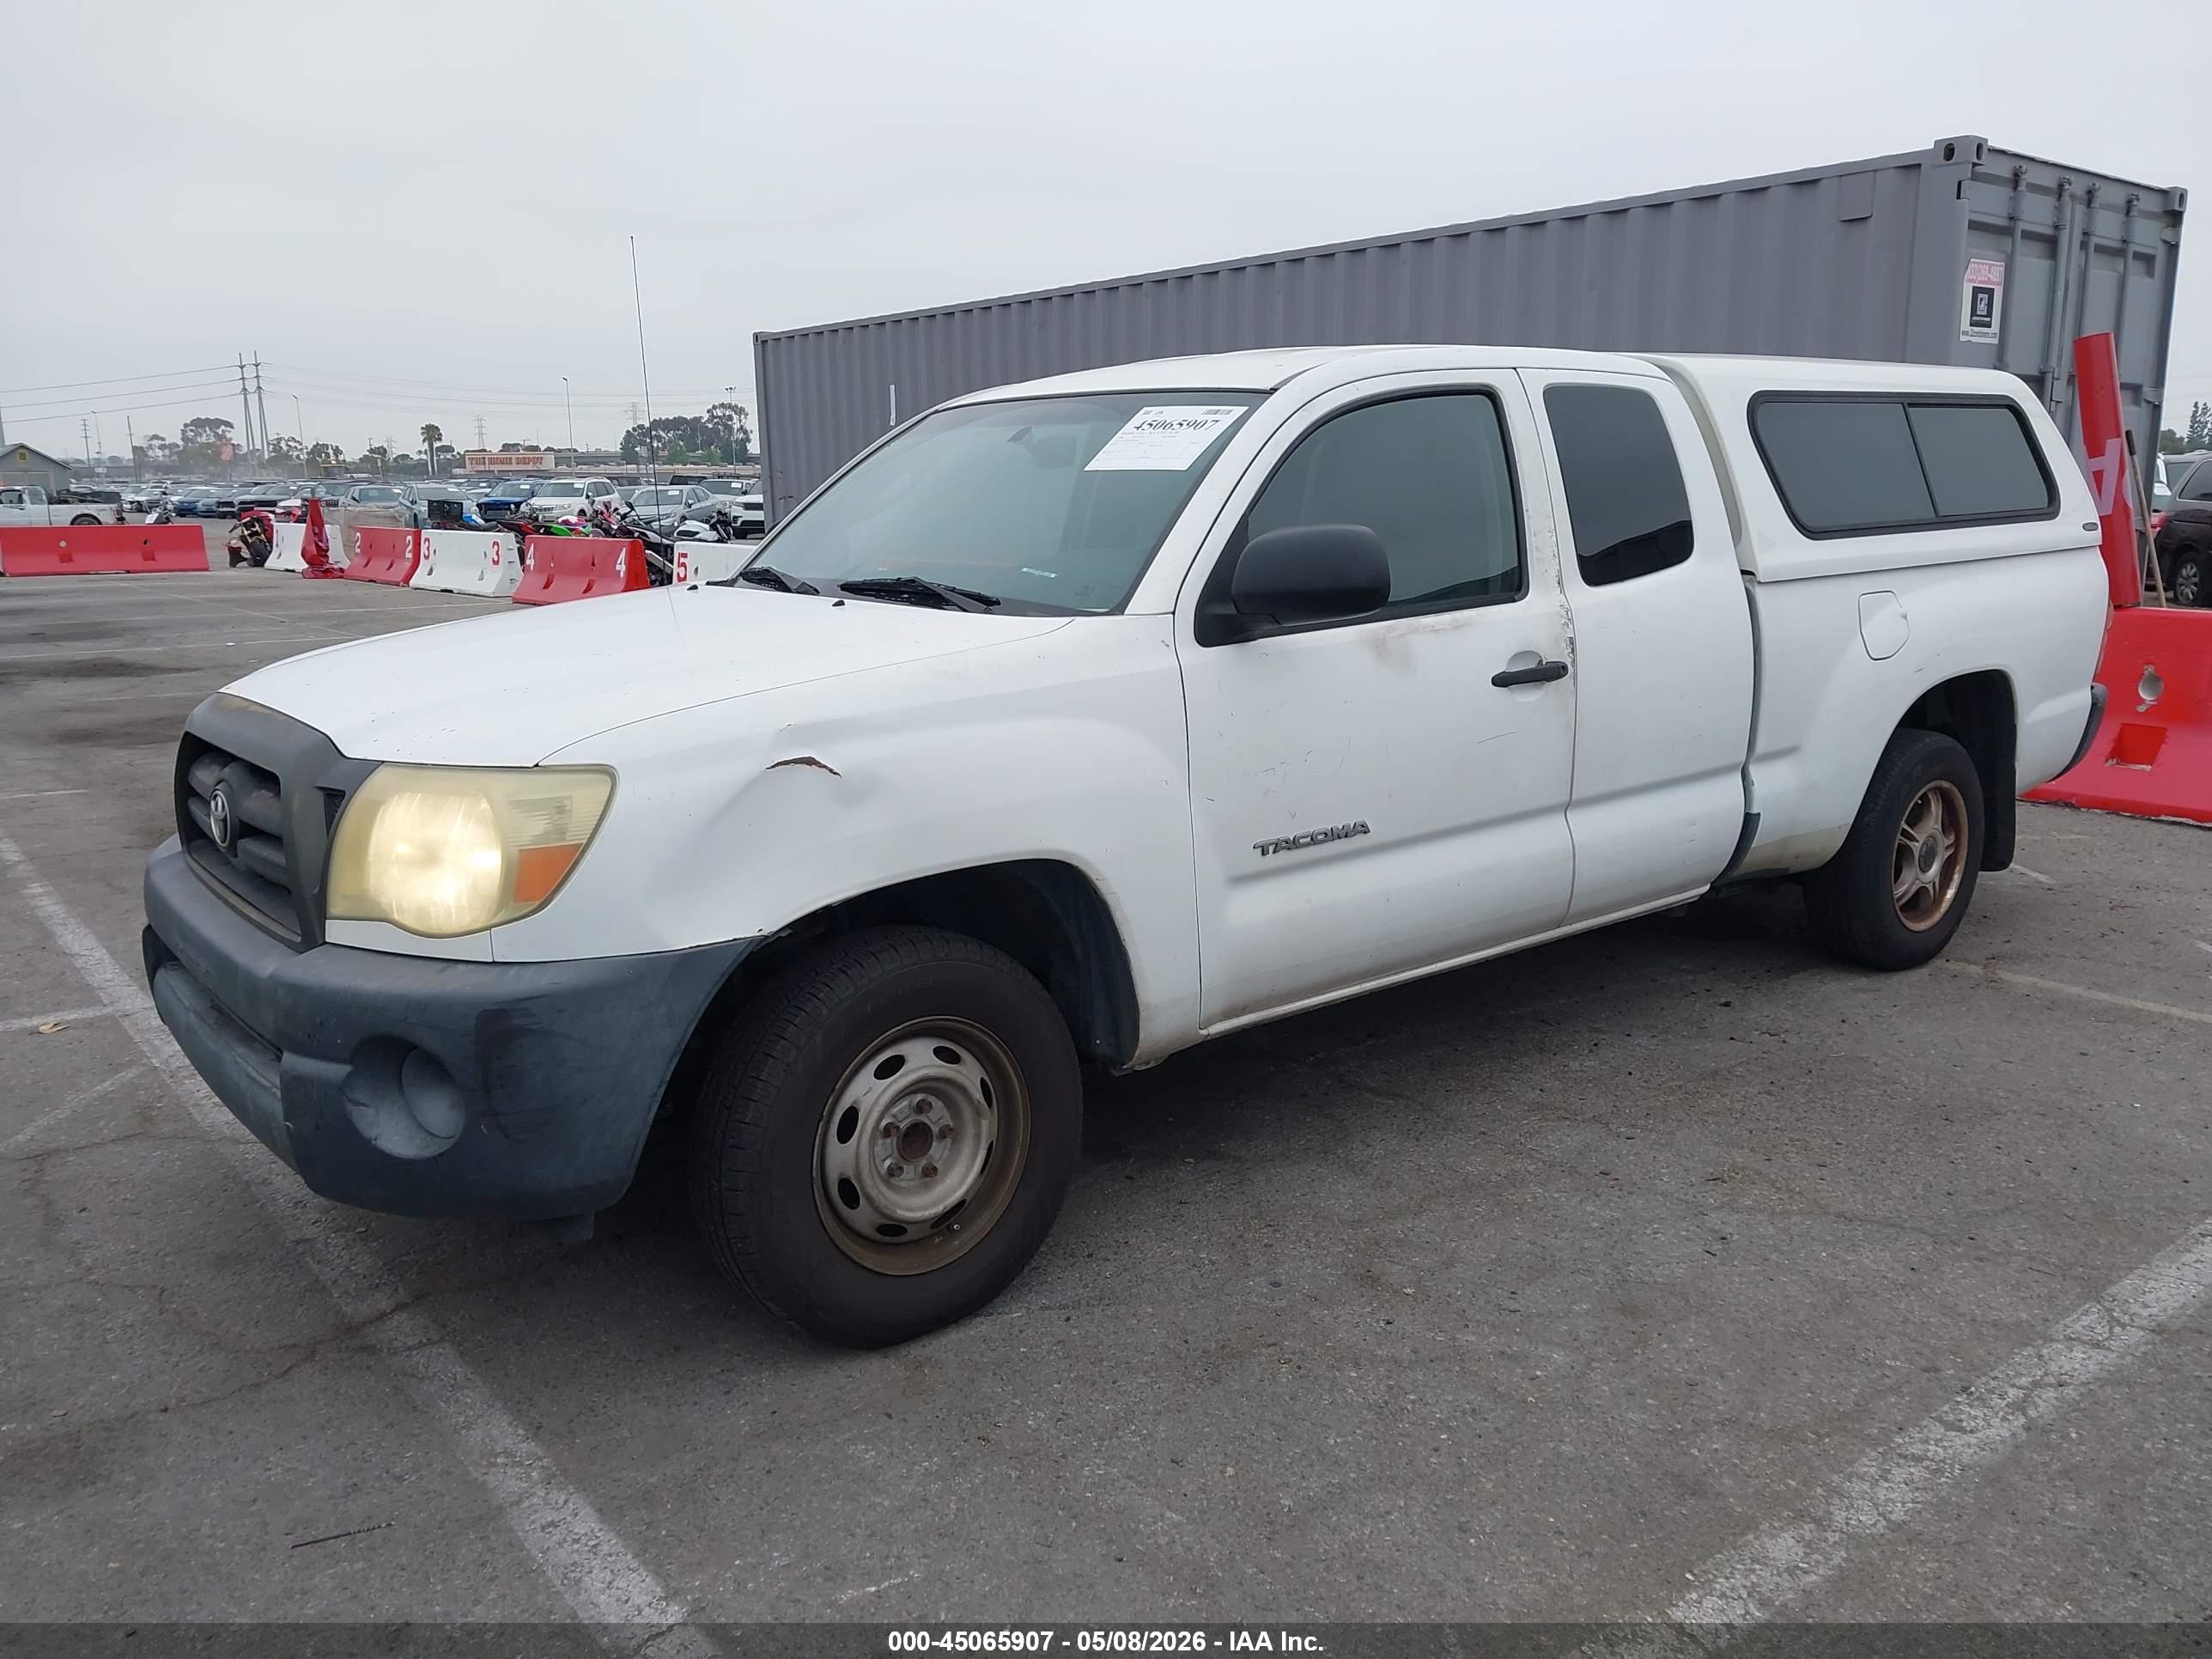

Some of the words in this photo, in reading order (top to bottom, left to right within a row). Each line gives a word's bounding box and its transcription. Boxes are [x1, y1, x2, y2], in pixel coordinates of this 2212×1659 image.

[1133, 419, 1221, 431] 45065907
[355, 532, 362, 554] 2
[405, 535, 413, 558] 2
[422, 537, 430, 560] 3
[491, 540, 501, 566] 3
[526, 543, 535, 570] 4
[615, 547, 626, 578] 4
[676, 551, 688, 583] 5
[1252, 818, 1371, 856] TACOMA
